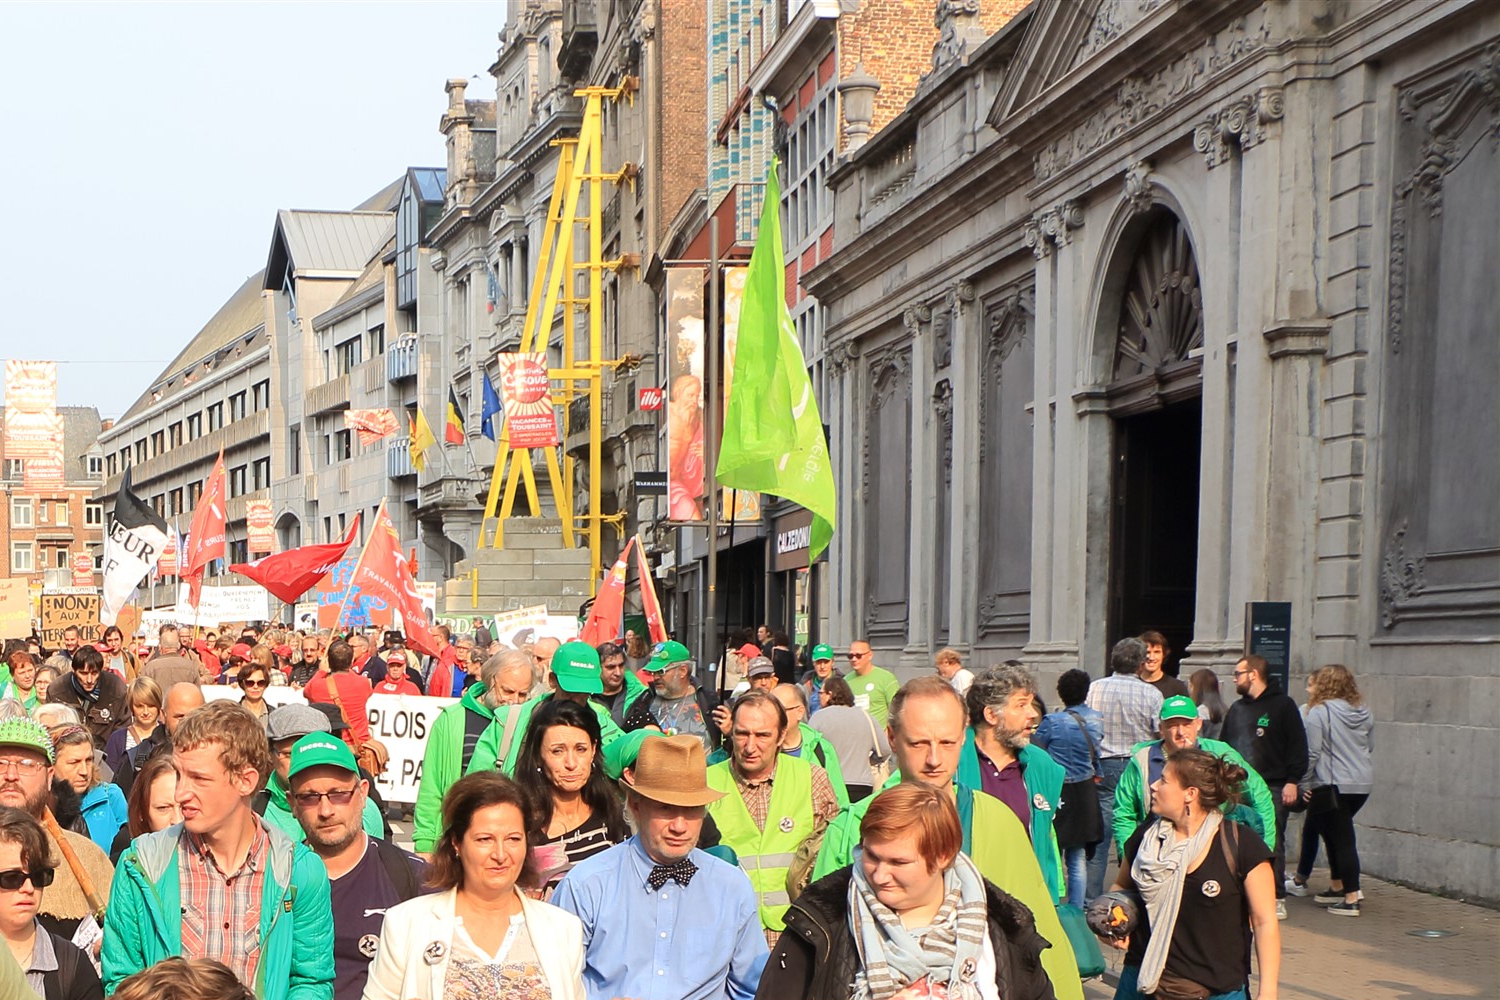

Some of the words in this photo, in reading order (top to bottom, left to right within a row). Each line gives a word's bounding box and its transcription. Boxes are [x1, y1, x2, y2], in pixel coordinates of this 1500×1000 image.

[640, 390, 661, 409] illy
[511, 423, 553, 431] TOUSSAINT
[59, 611, 80, 621] AUX
[406, 610, 426, 629] SANS
